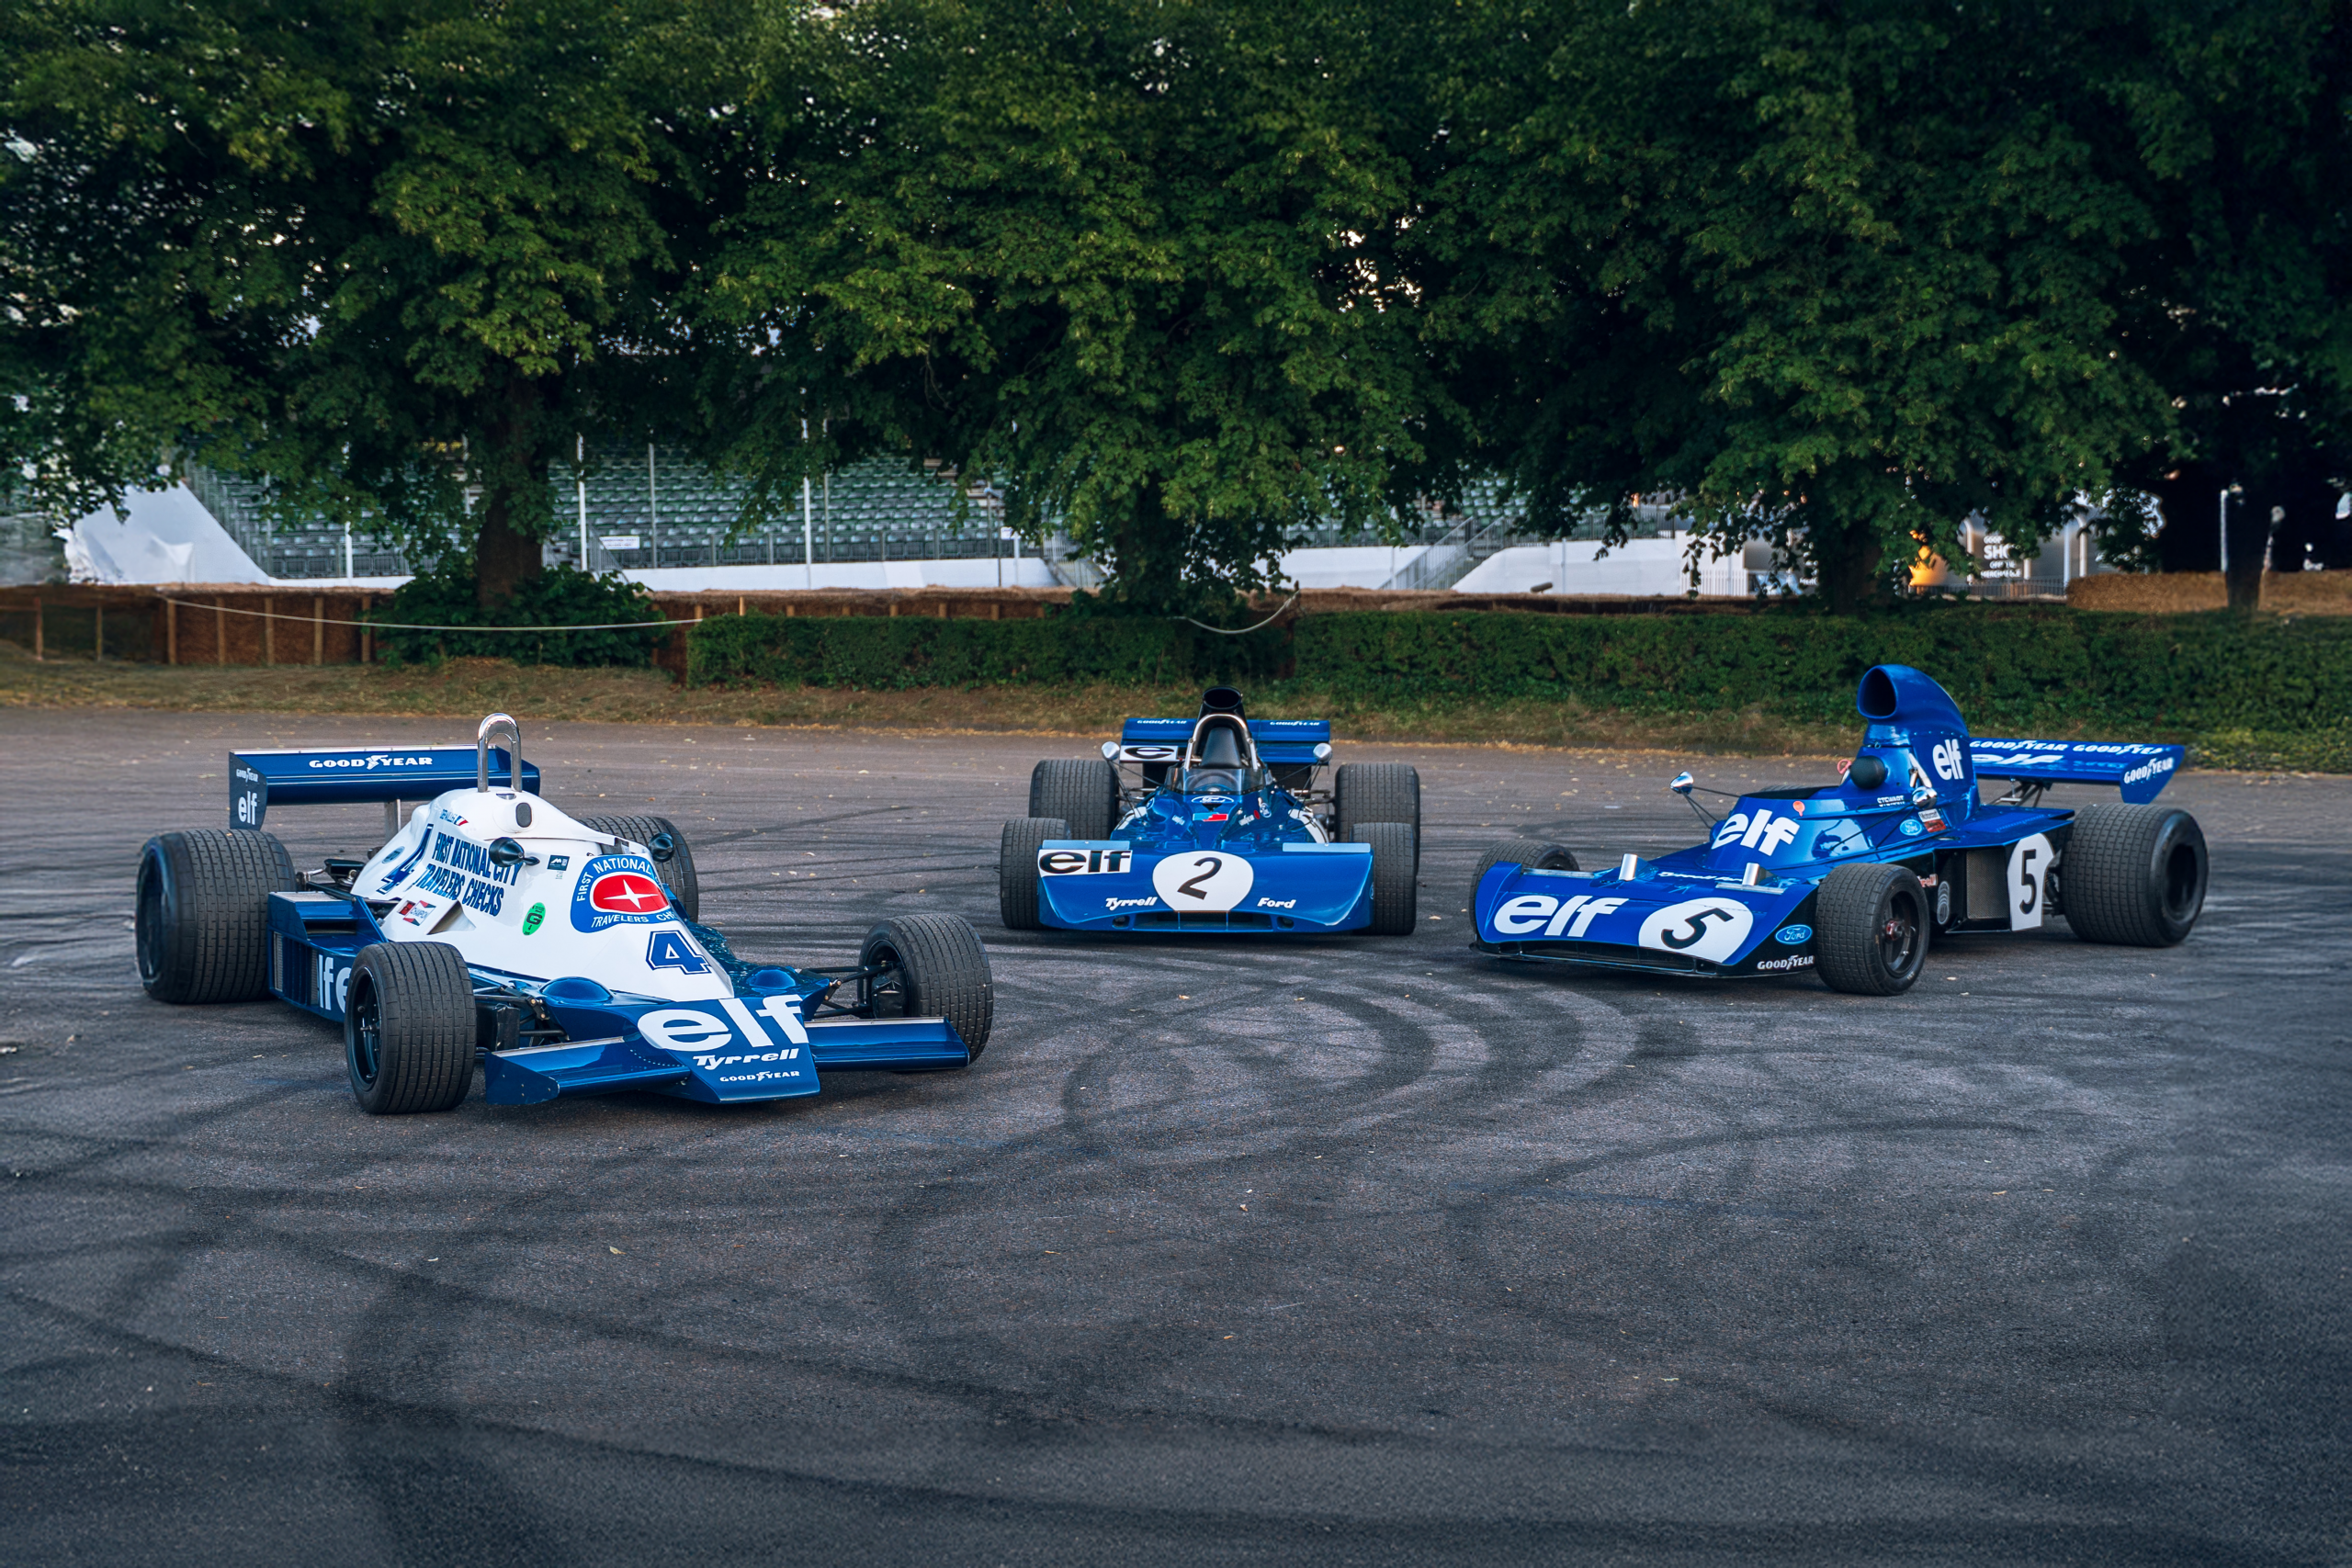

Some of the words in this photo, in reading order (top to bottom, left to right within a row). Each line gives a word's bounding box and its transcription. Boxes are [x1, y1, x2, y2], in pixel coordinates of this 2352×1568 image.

[309, 755, 433, 770] GOODYEAR
[1932, 739, 1964, 780] elf
[1970, 740, 2069, 751] GOODYEAR
[236, 768, 259, 782] GOODYEAR
[2123, 757, 2175, 784] GOODYEAR
[238, 791, 258, 825] elf
[1711, 808, 1800, 856] elf
[376, 824, 434, 895] 4
[432, 832, 454, 864] FIRST
[450, 839, 492, 878] NATIONAL
[1039, 851, 1131, 874] elf
[413, 863, 466, 900] TRAVELERS
[462, 877, 504, 917] CHECKS
[576, 872, 594, 902] FIRST
[593, 857, 652, 875] NATIONAL
[1177, 857, 1222, 900] 2
[2019, 849, 2037, 915] 5
[526, 912, 543, 925] G
[1105, 897, 1158, 910] Tyrrell
[1257, 897, 1296, 908] Ford
[1494, 895, 1629, 937] elf
[591, 915, 650, 928] TRAVELERS
[1661, 908, 1734, 949] 5
[646, 931, 712, 975] 4
[1757, 954, 1815, 970] GOODYEAR
[638, 994, 808, 1052] elf
[693, 1048, 799, 1070] Tyrrell
[719, 1070, 800, 1082] GOODYEAR
